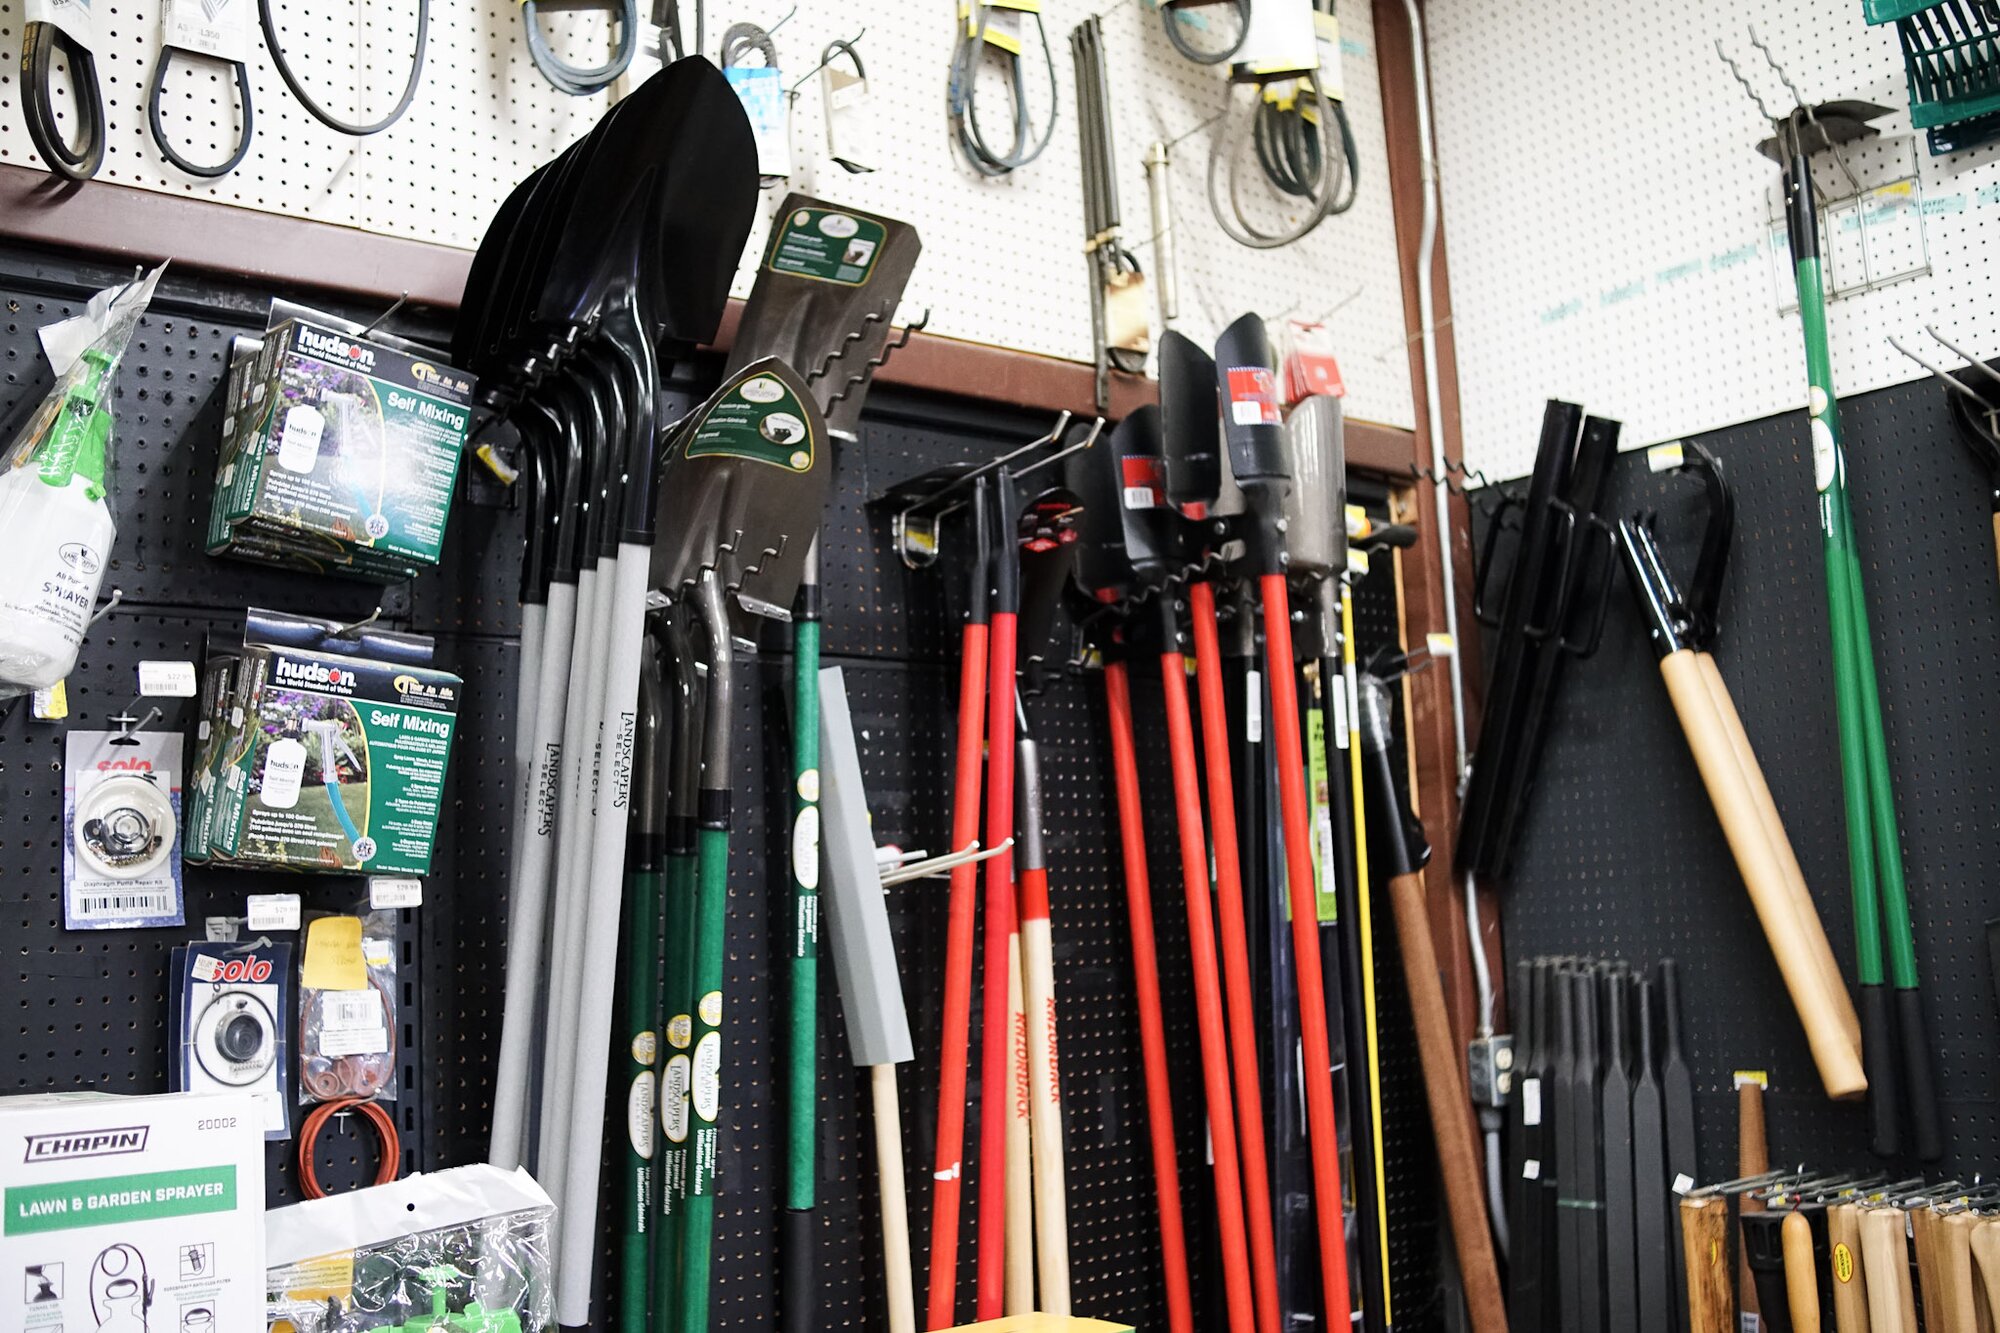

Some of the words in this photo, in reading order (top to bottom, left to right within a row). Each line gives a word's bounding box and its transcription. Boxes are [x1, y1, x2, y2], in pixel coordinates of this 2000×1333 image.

[387, 391, 417, 413] Self
[418, 401, 465, 431] Mixing
[276, 656, 355, 688] hudson
[276, 676, 286, 684] The
[287, 678, 304, 687] World
[304, 680, 329, 692] Standard
[330, 684, 336, 692] of
[337, 686, 352, 695] Value
[370, 710, 400, 728] Self
[402, 714, 450, 738] Mixing
[592, 743, 602, 795] SELECT
[612, 733, 624, 785] SELECT
[614, 712, 634, 809] LANDSCAPERS
[538, 763, 548, 813] SELECT
[538, 742, 560, 838] LANDSCAPERS
[252, 809, 270, 817] Sprays
[212, 955, 272, 983] solo
[638, 1082, 650, 1148] LANDSCAPERS
[668, 1065, 682, 1132] LANDSCAPERS
[198, 1117, 237, 1130] 20002
[34, 1132, 140, 1156] CHAPIN
[696, 1128, 705, 1164] Utilisation
[704, 1143, 712, 1169] general
[665, 1150, 673, 1184] Utilisation
[672, 1164, 680, 1190] general
[694, 1164, 704, 1195] Générale
[20, 1198, 66, 1218] LAWN
[72, 1196, 83, 1211] &
[88, 1189, 151, 1210] GARDEN
[156, 1182, 224, 1202] SPRAYER
[637, 1168, 645, 1202] Utilisation
[664, 1184, 672, 1215] Générale
[637, 1202, 645, 1232] Générale
